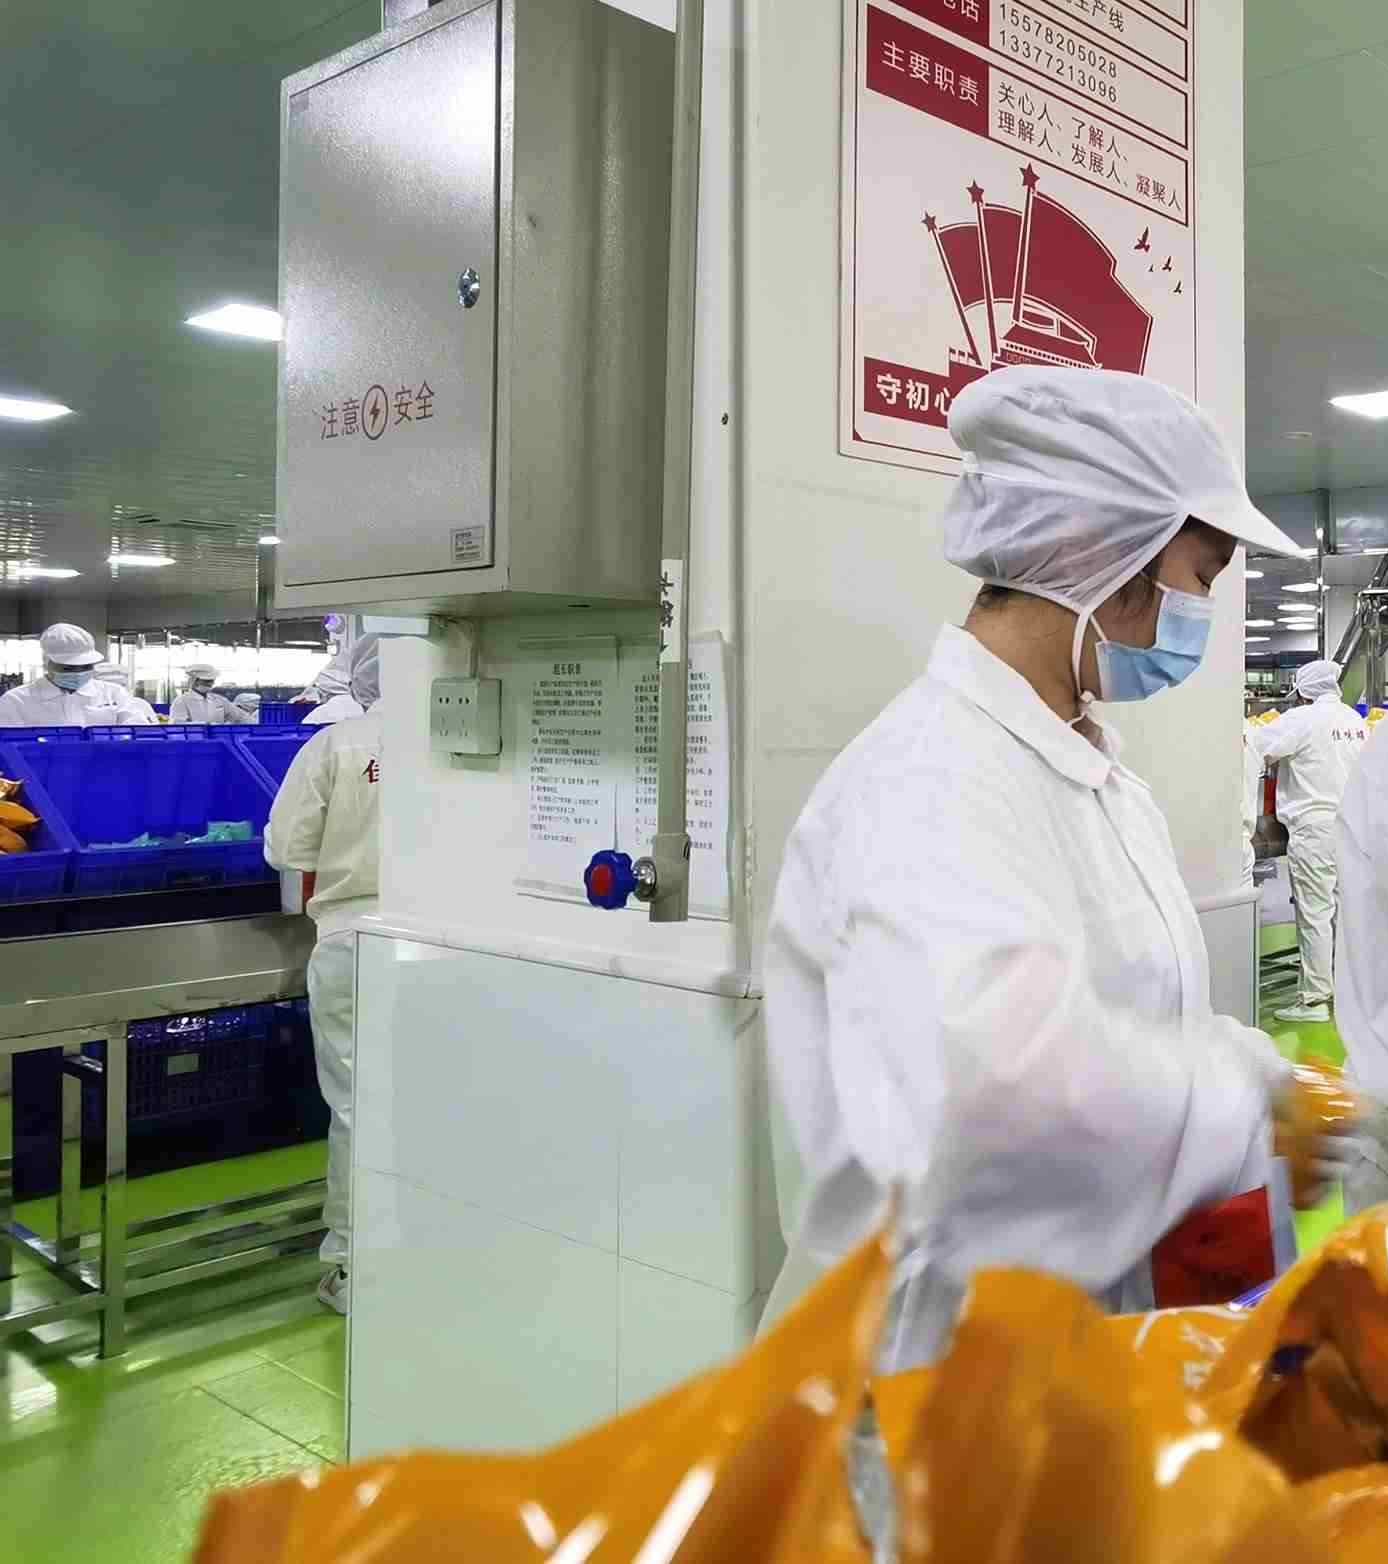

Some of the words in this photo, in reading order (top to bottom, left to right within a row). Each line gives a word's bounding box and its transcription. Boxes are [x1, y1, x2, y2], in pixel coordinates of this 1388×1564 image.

[881, 40, 980, 107] 主要职责
[999, 3, 1117, 78] 15578205028
[999, 30, 1117, 103] 13377213096
[321, 398, 361, 440] 注意
[393, 380, 435, 425] 安全
